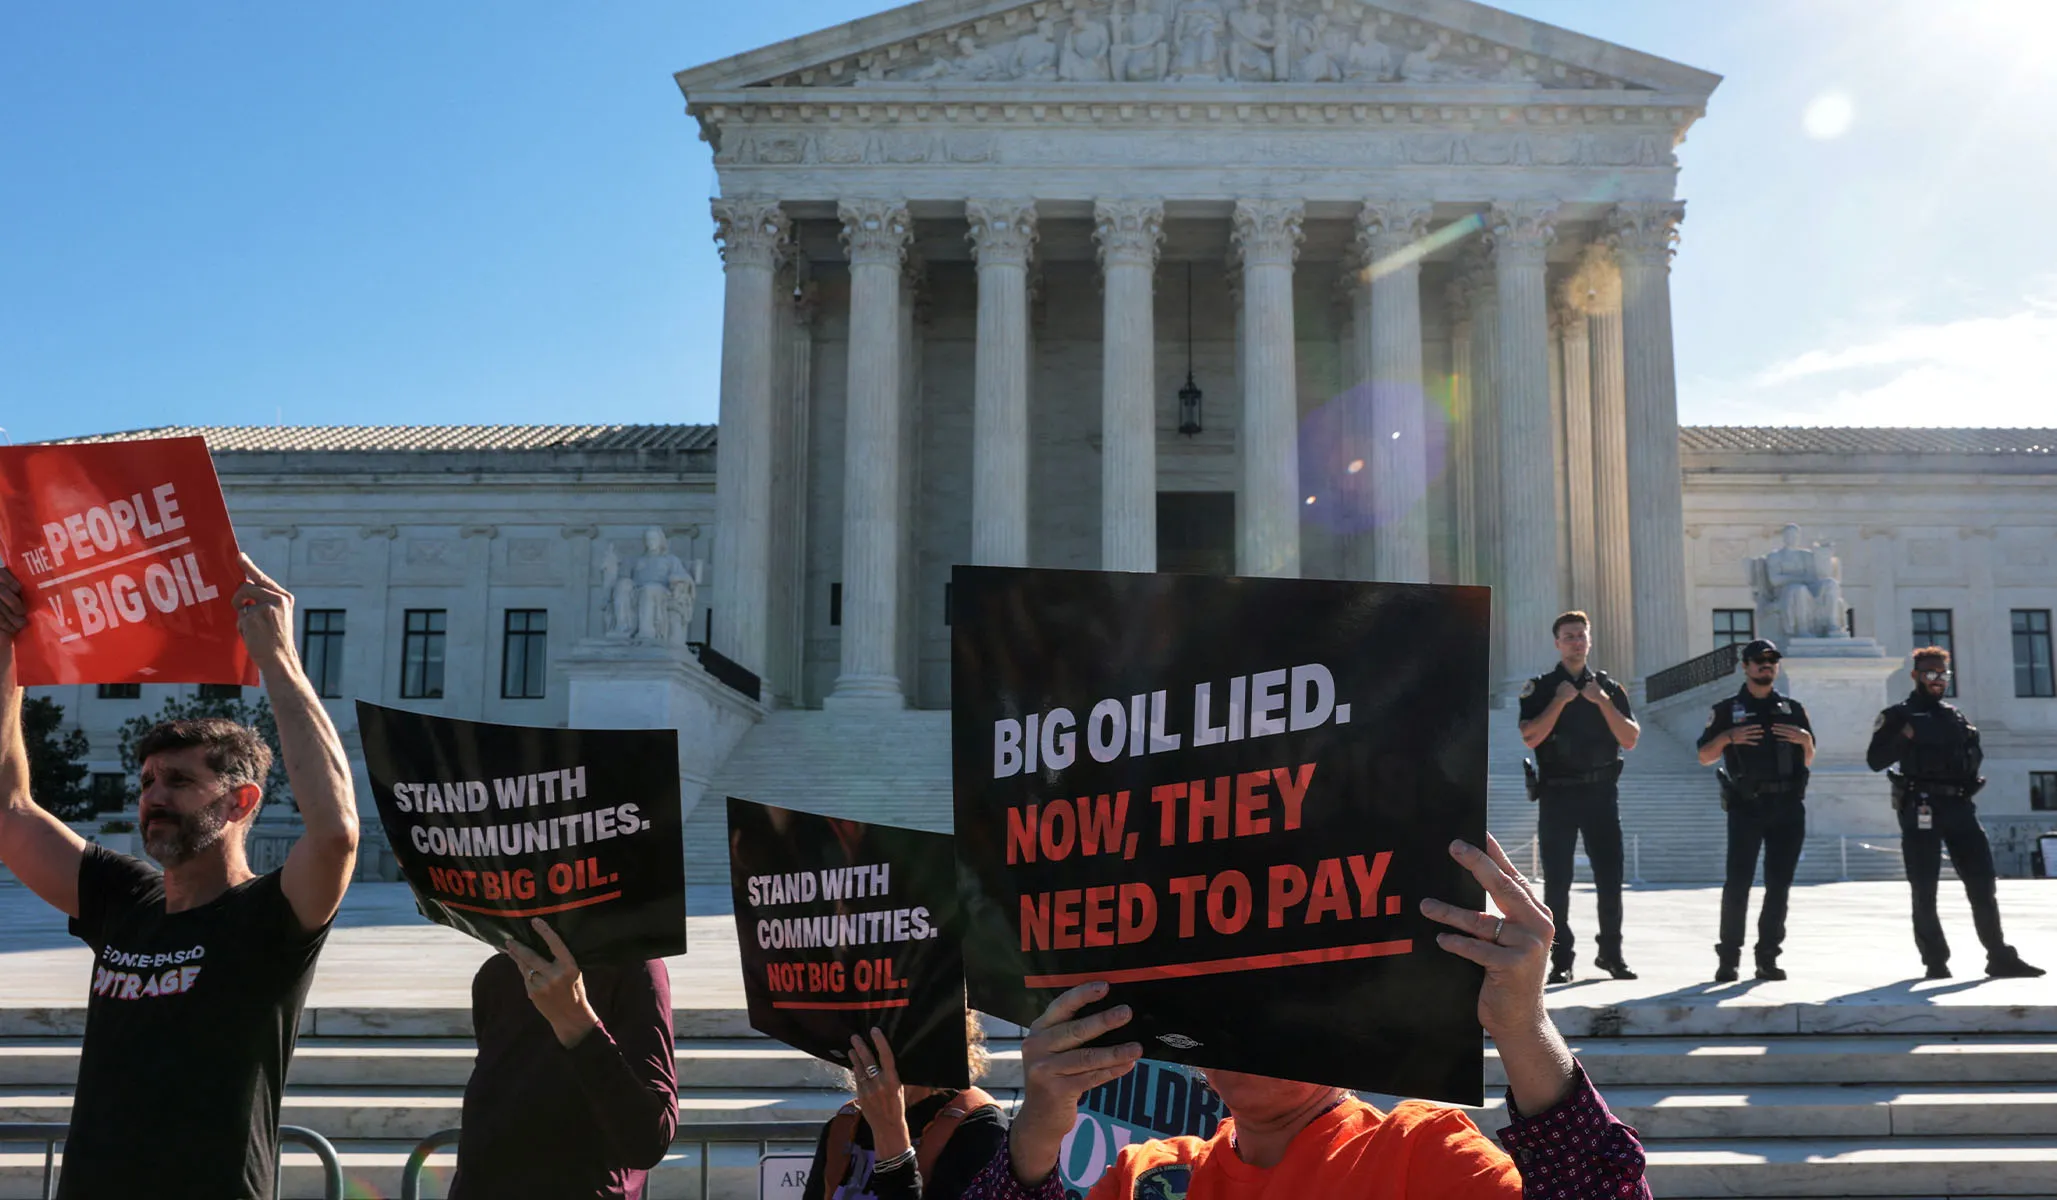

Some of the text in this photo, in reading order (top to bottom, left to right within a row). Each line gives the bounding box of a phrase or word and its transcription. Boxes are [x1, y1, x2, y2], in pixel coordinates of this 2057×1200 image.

[22, 482, 186, 576] THE PEOPLE
[48, 553, 219, 637] V. BIG OIL
[993, 662, 1352, 779] BIG OIL LIED.
[393, 766, 587, 813] STAND WITH
[1006, 762, 1317, 866] NOW, THEY
[411, 803, 650, 857] COMMUNITIES.
[428, 857, 619, 900] NOT BIG OIL.
[747, 863, 890, 907] STAND WITH
[1020, 850, 1401, 952] NEED TO PAY.
[757, 906, 938, 950] COMMUNITIES.
[766, 957, 908, 993] NOT BIG OIL.
[1077, 1061, 1235, 1142] HILDR
